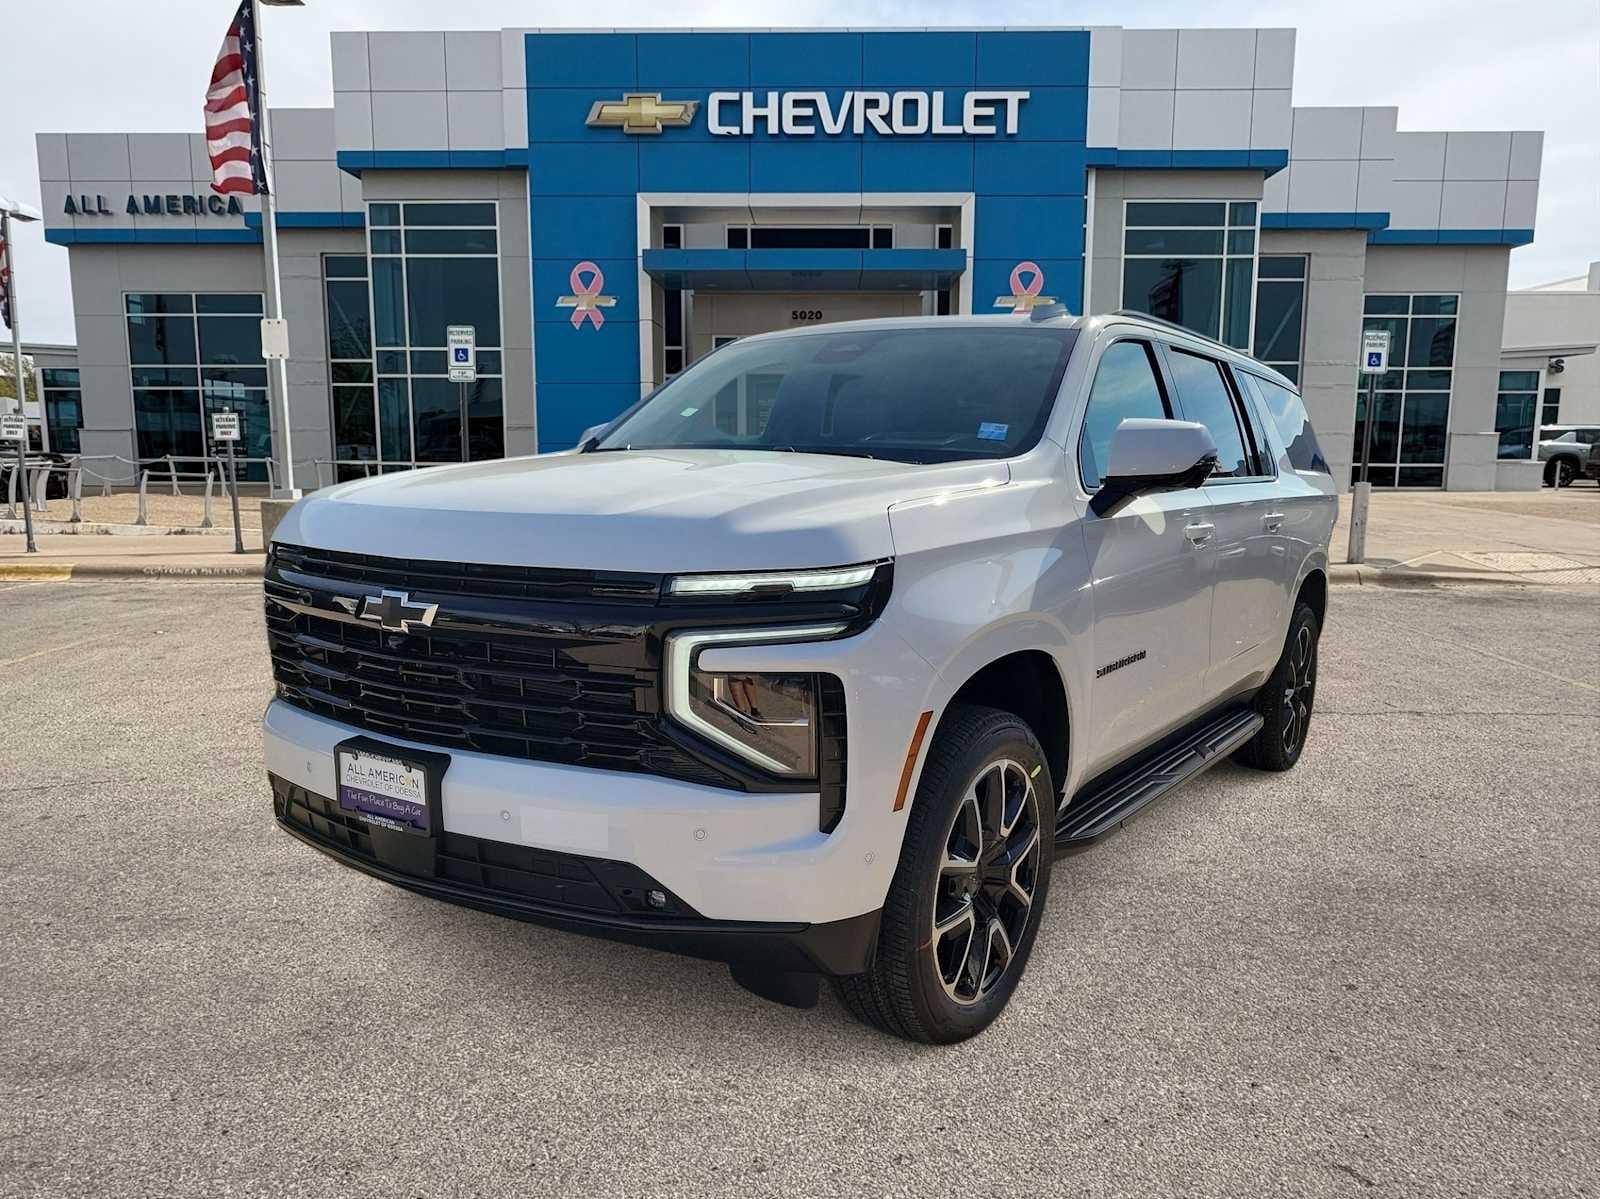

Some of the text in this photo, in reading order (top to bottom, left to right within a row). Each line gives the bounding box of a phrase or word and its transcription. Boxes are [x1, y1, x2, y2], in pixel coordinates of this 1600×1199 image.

[707, 90, 1031, 136] CHEVROLET
[64, 195, 244, 215] ALL AMERICA
[791, 310, 823, 320] 5020
[347, 762, 365, 776] ALL
[345, 774, 422, 800] CHEVROLET OF ODESSA
[346, 789, 358, 800] The
[369, 794, 385, 808] Place
[385, 799, 393, 809] To
[392, 801, 405, 815] Buy
